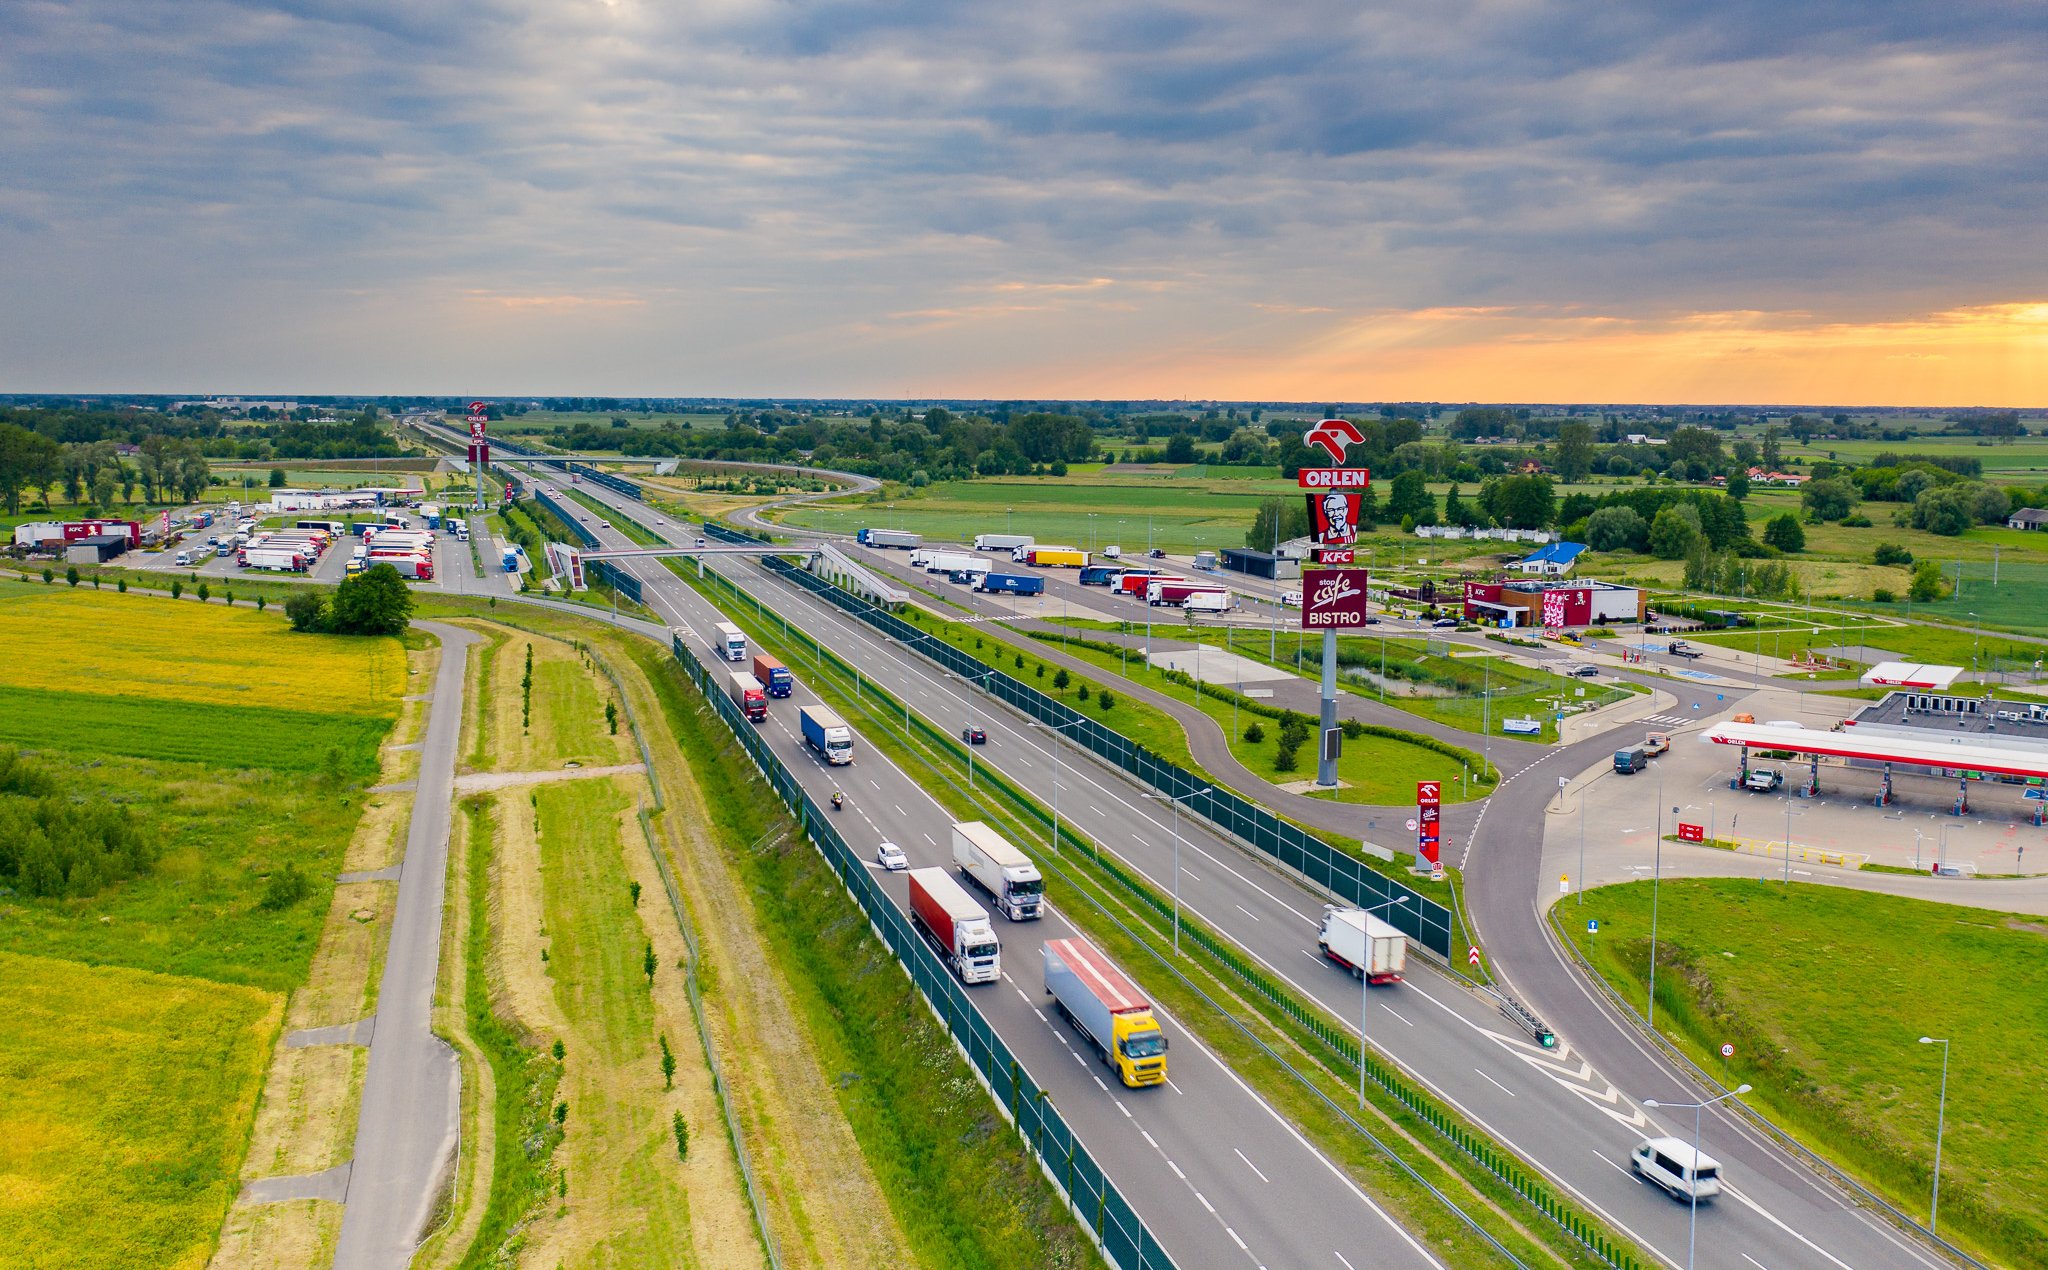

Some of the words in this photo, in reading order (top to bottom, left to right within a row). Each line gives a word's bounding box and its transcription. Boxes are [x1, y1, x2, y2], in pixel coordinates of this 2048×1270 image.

[1306, 471, 1365, 486] ORLEN
[1322, 552, 1351, 563] KFC
[1313, 572, 1351, 606] cafe
[1309, 612, 1360, 624] BISTRO
